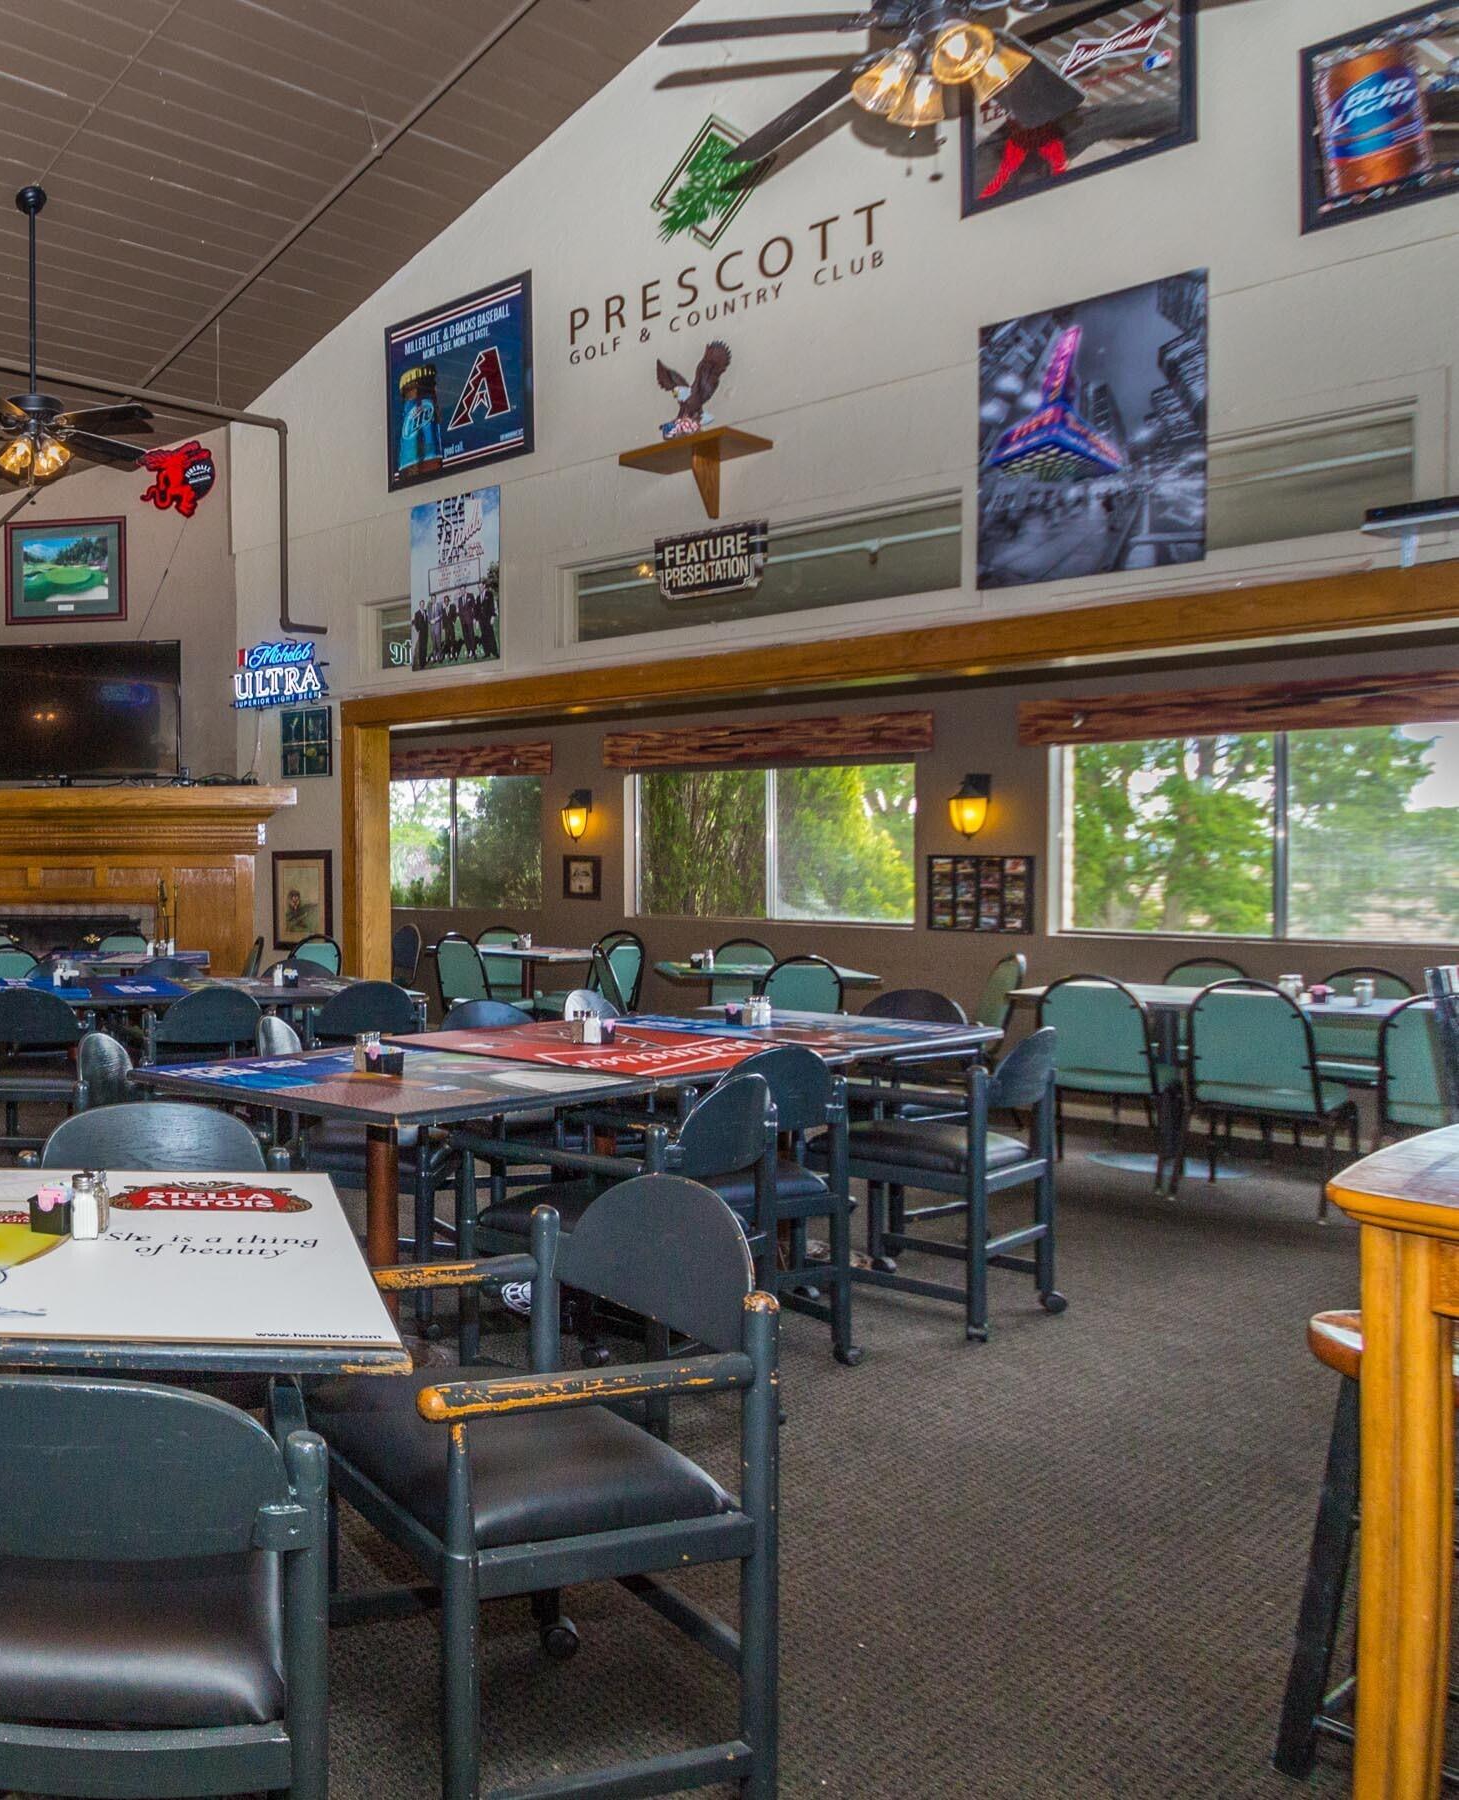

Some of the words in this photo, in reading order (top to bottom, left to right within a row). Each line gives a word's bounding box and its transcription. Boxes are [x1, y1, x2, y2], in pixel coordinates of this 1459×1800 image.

[1057, 16, 1168, 69] Budweiser
[1346, 75, 1412, 109] BUD
[1330, 89, 1417, 134] LIGHT
[569, 199, 887, 346] PRESCOTT
[569, 336, 621, 365] GOLF
[639, 327, 651, 342] &
[668, 281, 783, 333] COUNTRY
[813, 251, 884, 286] CLUB
[404, 335, 427, 356] MILLER
[427, 331, 440, 348] LITE
[443, 328, 449, 341] &
[477, 303, 511, 328] BASEBALL
[664, 532, 748, 567] FEATURE
[665, 555, 749, 589] PRESENTATION
[248, 642, 312, 668] Michelob
[234, 664, 320, 700] ULTRA
[235, 697, 270, 708] SUPERIOR
[273, 695, 295, 704] LIGHT
[145, 1199, 274, 1208] ARTOIS
[148, 1192, 271, 1200] STELLA
[107, 1232, 152, 1241] She
[173, 1234, 194, 1243] is
[238, 1234, 318, 1248] thing
[135, 1244, 173, 1256] of
[180, 1244, 287, 1259] beauty
